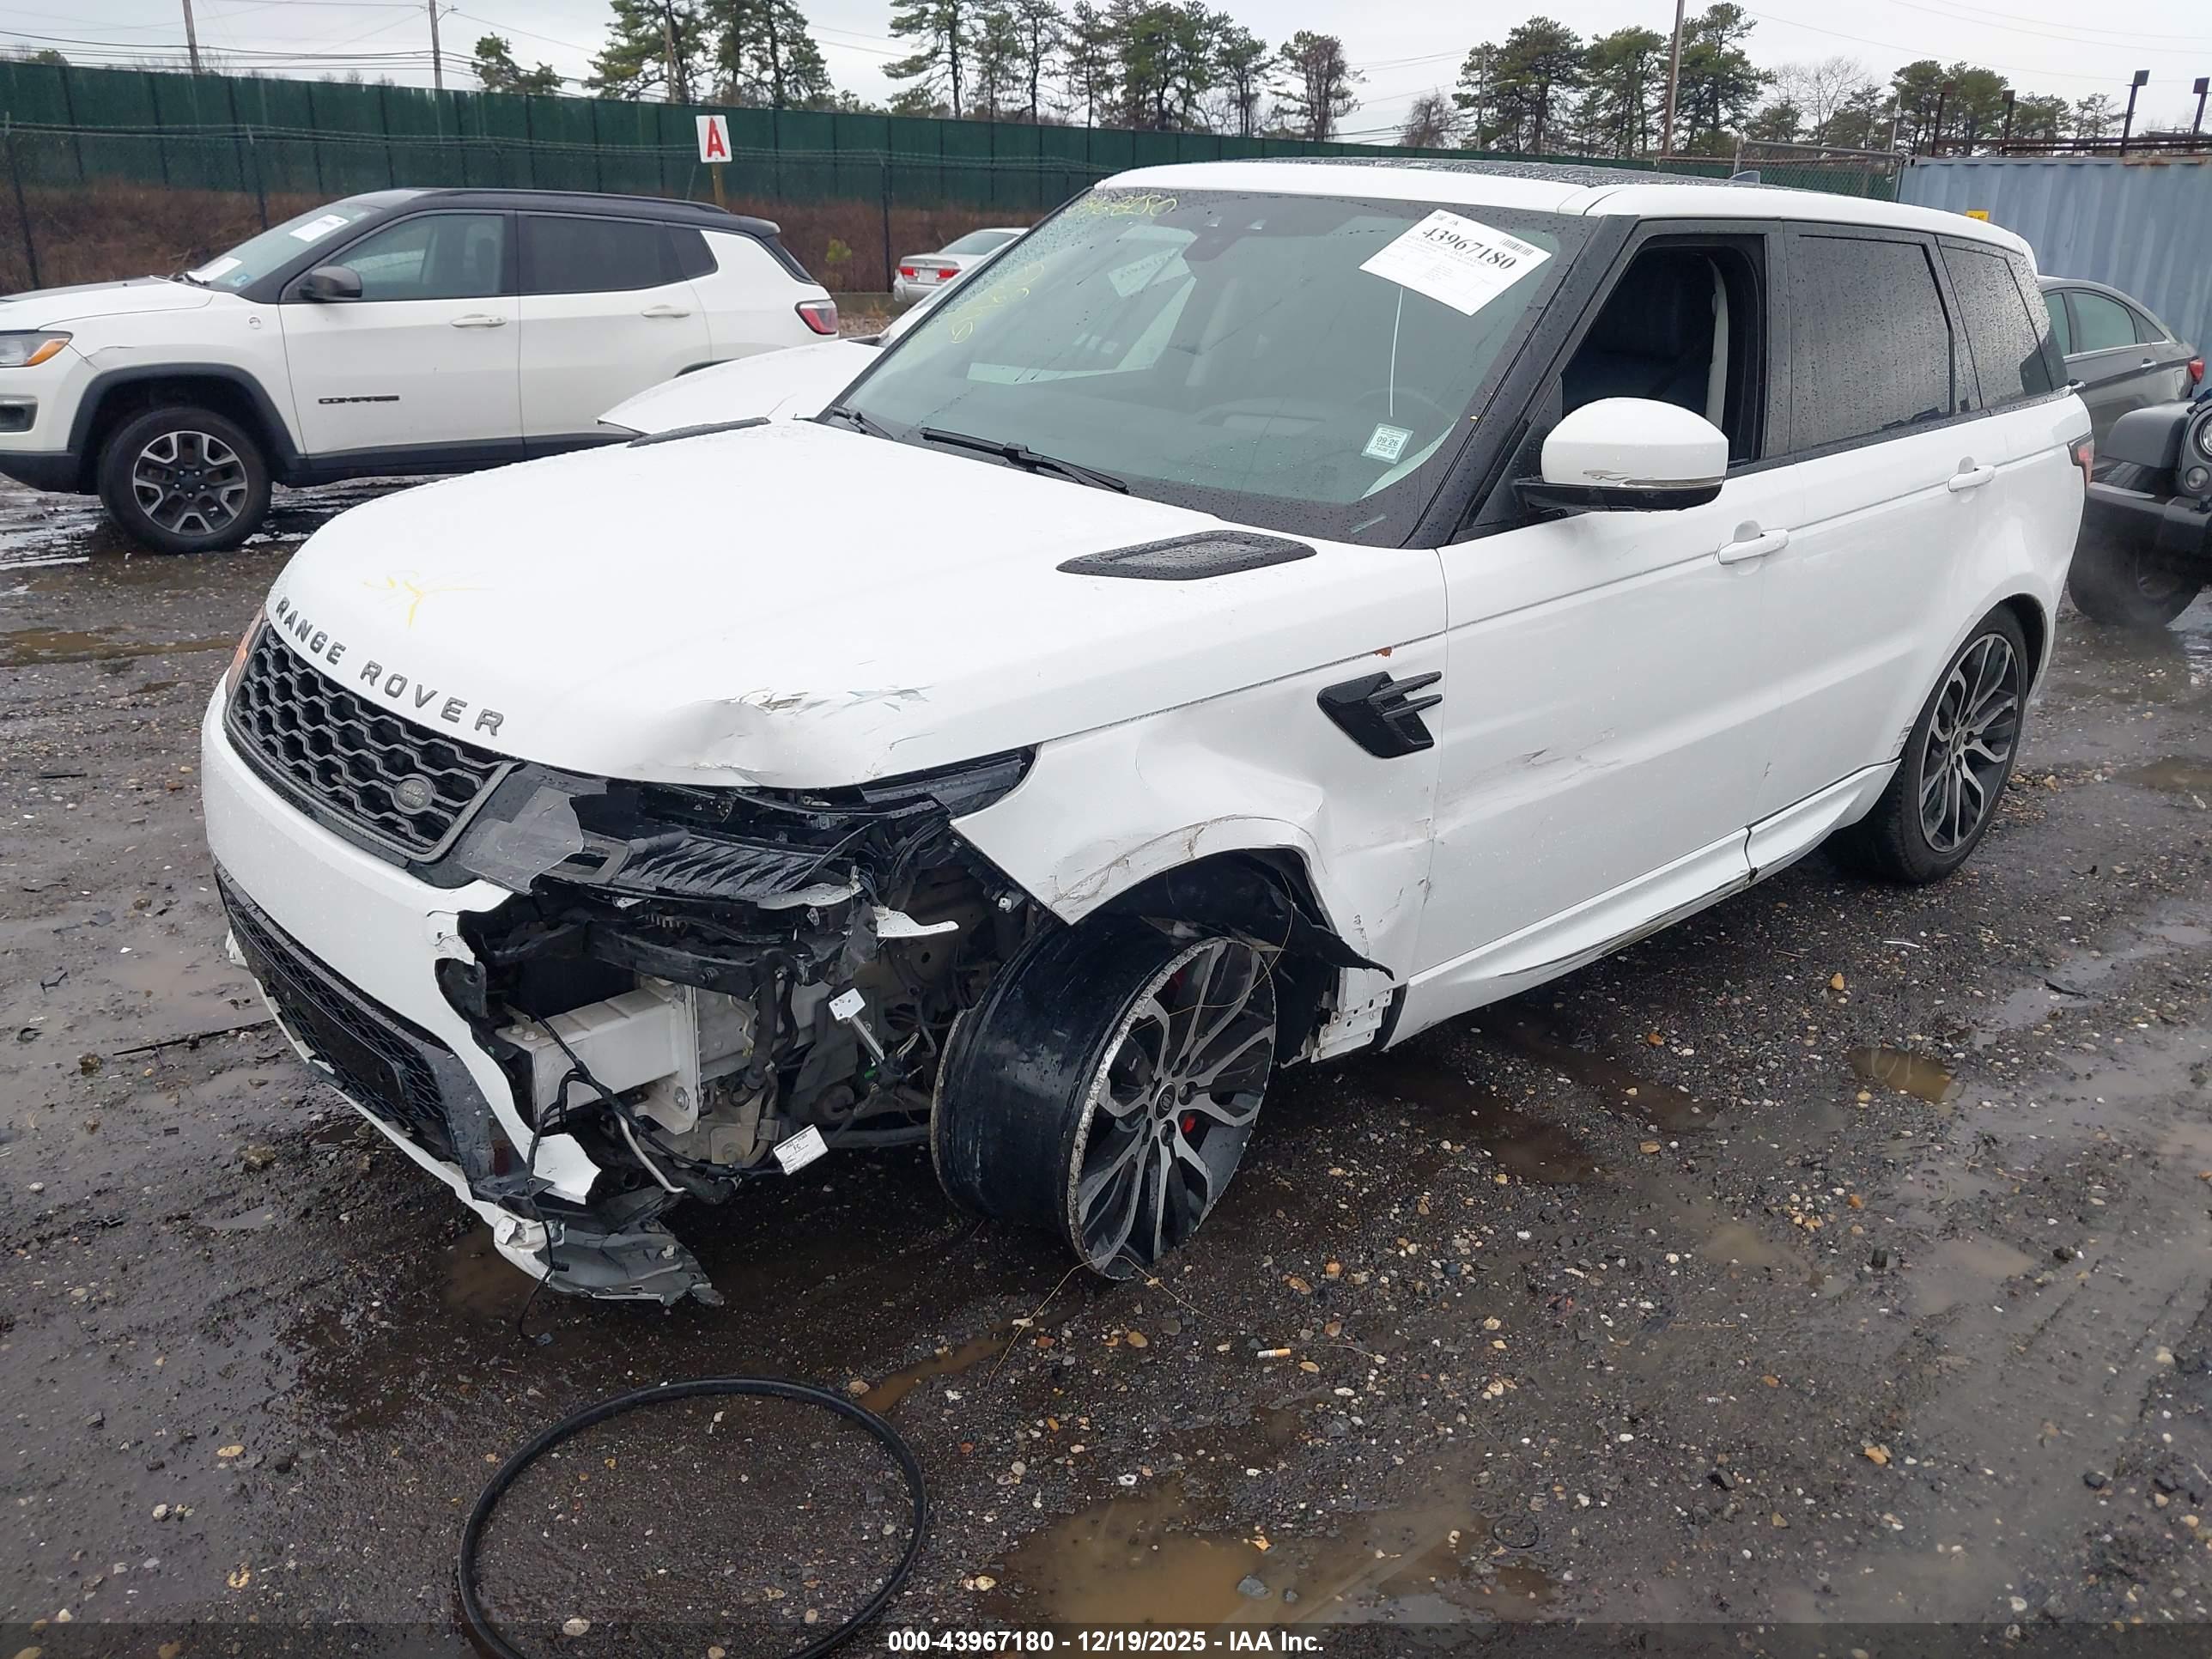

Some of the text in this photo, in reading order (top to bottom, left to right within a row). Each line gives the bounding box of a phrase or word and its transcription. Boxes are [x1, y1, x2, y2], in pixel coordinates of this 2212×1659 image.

[708, 117, 726, 157] A
[1422, 227, 1517, 270] 43967180
[275, 597, 505, 737] RANGE ROVER
